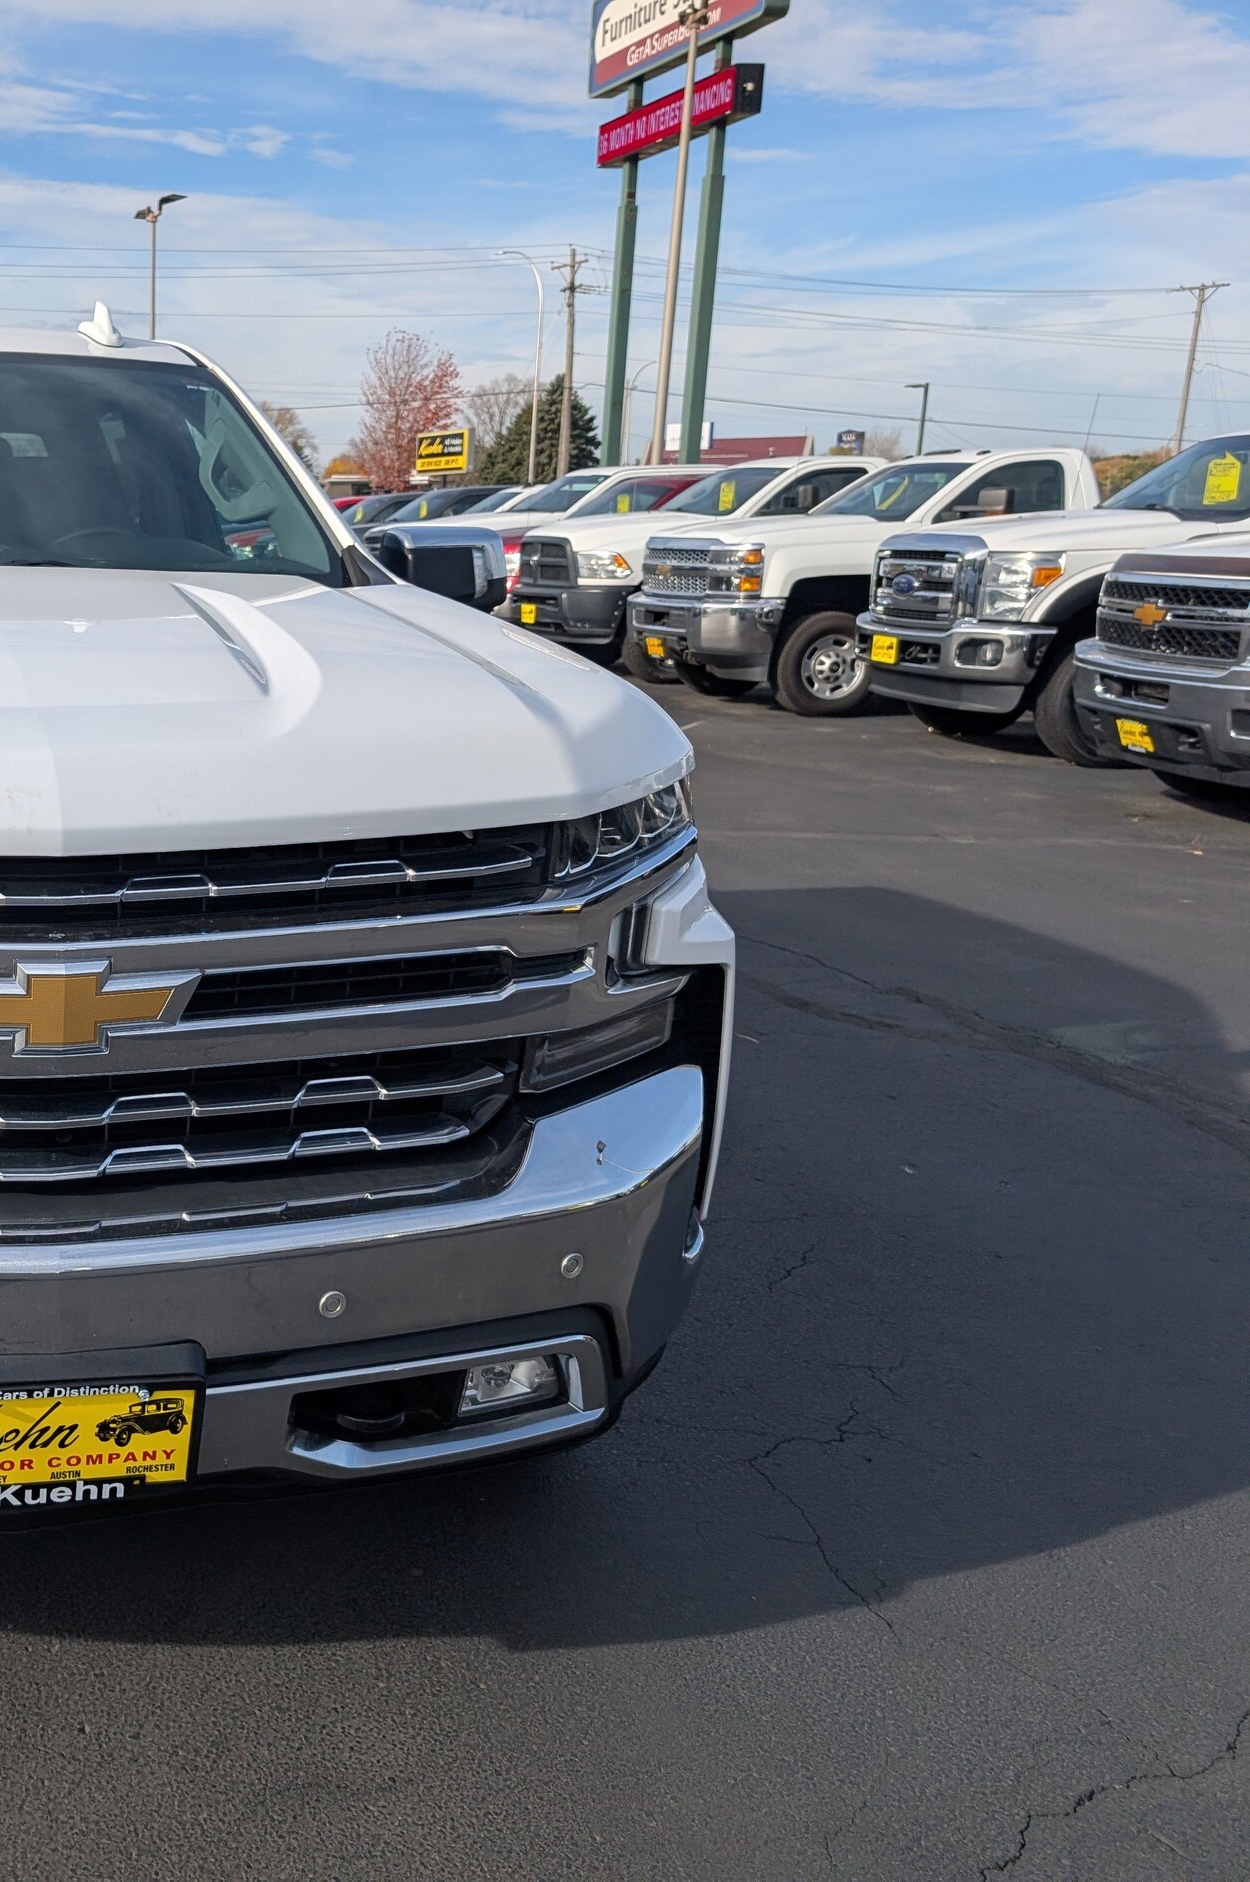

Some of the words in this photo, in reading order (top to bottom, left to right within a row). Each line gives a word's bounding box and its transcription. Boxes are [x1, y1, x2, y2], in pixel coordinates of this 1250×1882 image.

[601, 0, 667, 47] Furniture
[610, 121, 634, 150] MONTH
[635, 116, 646, 140] NO
[420, 460, 442, 468] SERVICE
[33, 1388, 49, 1399] of
[53, 1384, 140, 1398] Distinction
[47, 1449, 176, 1468] COMPANY
[50, 1470, 81, 1480] AUSTIN
[125, 1463, 176, 1474] ROCHESTER
